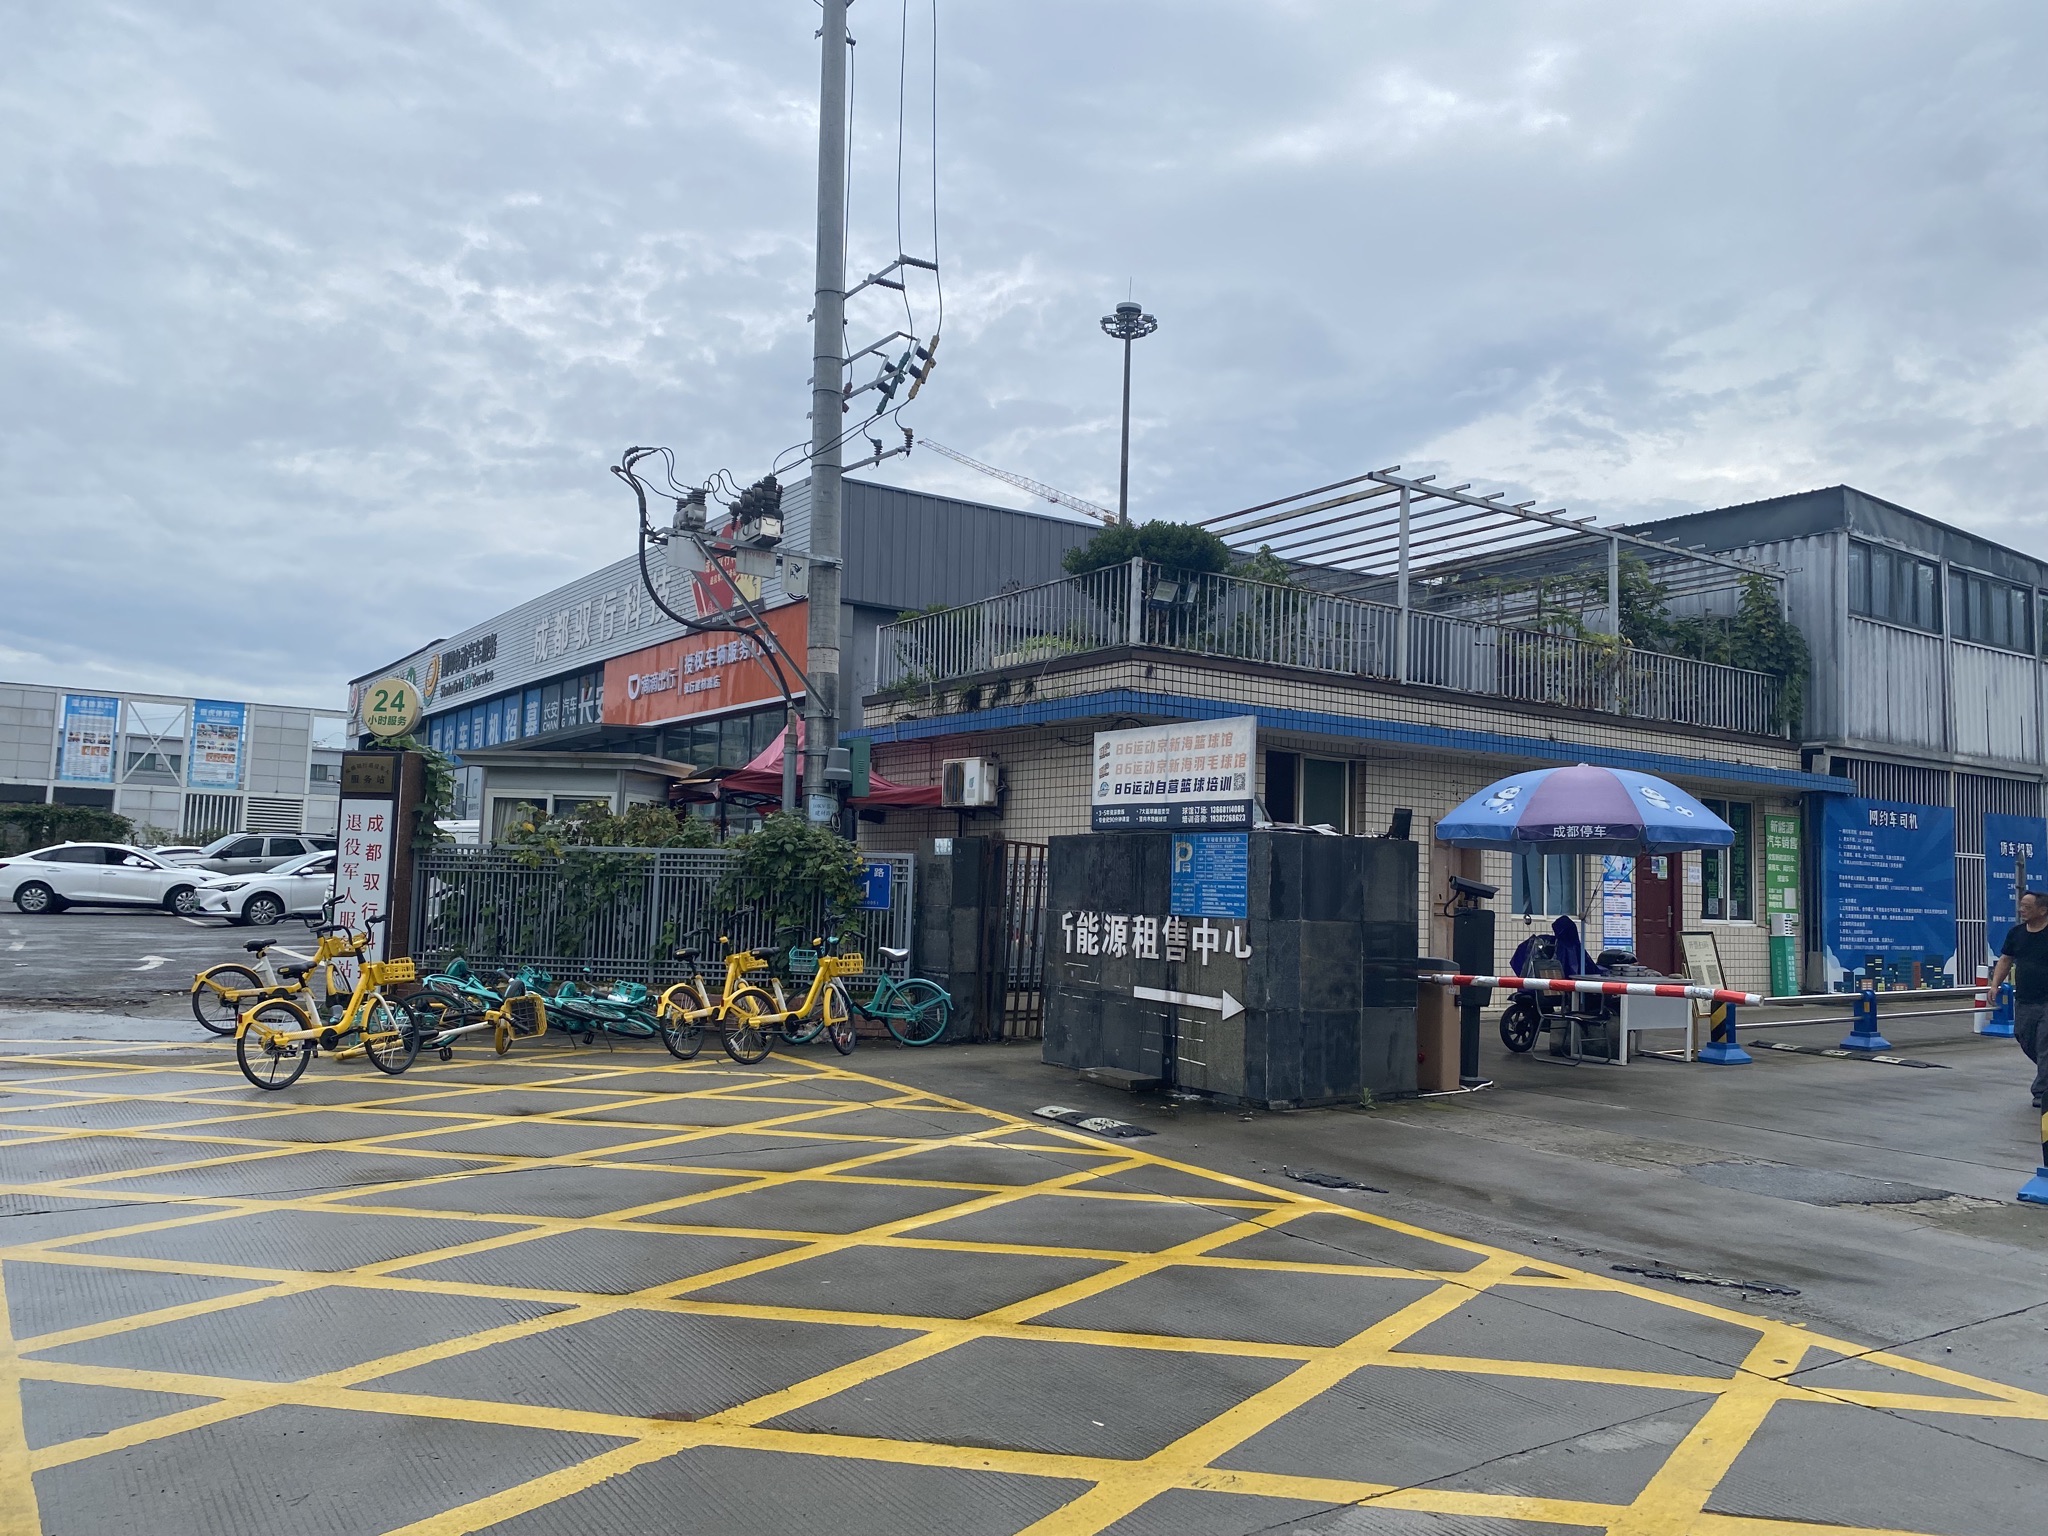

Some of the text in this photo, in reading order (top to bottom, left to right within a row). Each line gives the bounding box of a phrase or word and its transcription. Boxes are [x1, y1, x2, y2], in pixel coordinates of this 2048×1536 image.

[533, 568, 671, 664] 成都驭行科技
[640, 667, 678, 695] 滴滴出行
[373, 689, 405, 712] 24
[368, 715, 407, 726] 小时服务
[1115, 731, 1234, 756] 86运动京新海篮球馆
[1115, 752, 1248, 776] 86运动京新海羽毛球馆
[1114, 776, 1232, 795] 86运动自营篮球培训
[1770, 820, 1795, 834] 新能源
[1869, 809, 1918, 830] 网约车司机
[1553, 825, 1607, 838] 成都停车
[1767, 834, 1798, 849] 汽车销售
[1175, 842, 1193, 873] P
[336, 813, 362, 978] 退役军人服站
